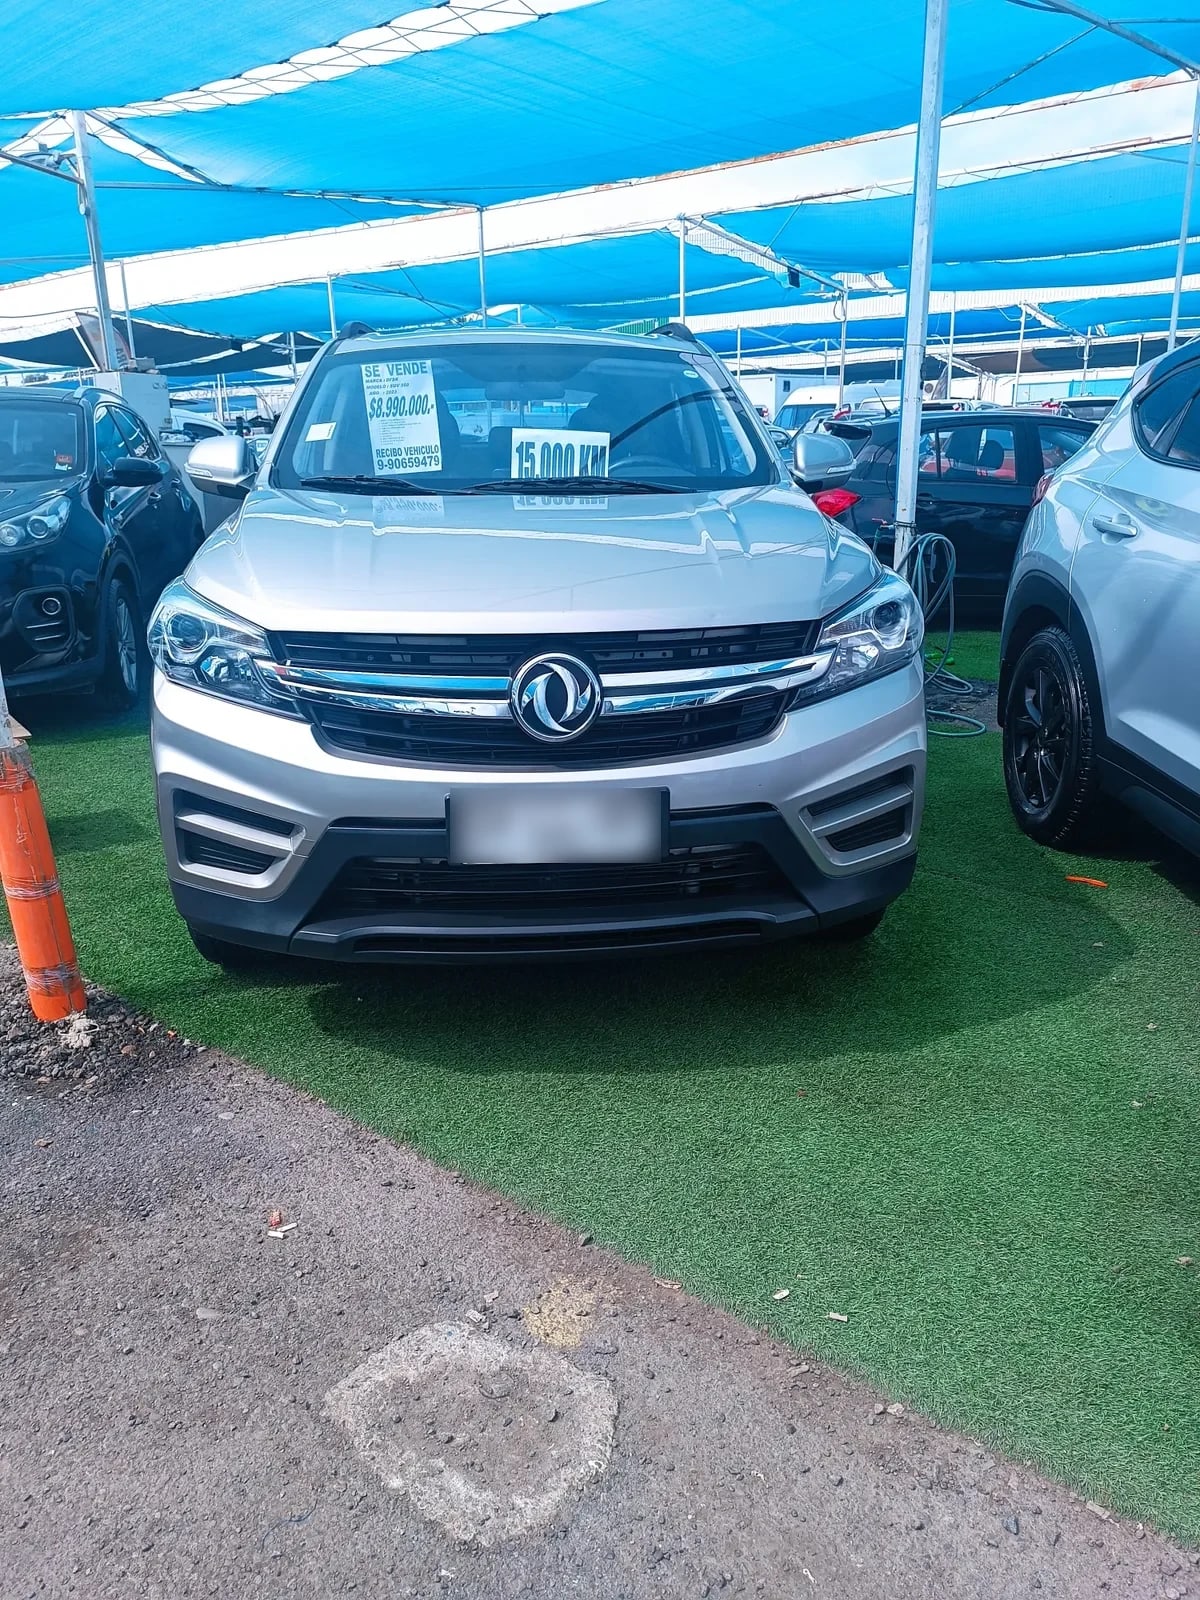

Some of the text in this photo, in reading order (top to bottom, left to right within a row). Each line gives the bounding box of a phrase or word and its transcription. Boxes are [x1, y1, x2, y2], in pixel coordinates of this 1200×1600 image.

[364, 361, 428, 378] SE VENDE
[375, 444, 440, 459] RECIBO VEHICULO
[515, 441, 607, 478] 15.000 KM
[377, 455, 440, 471] 9-90659479
